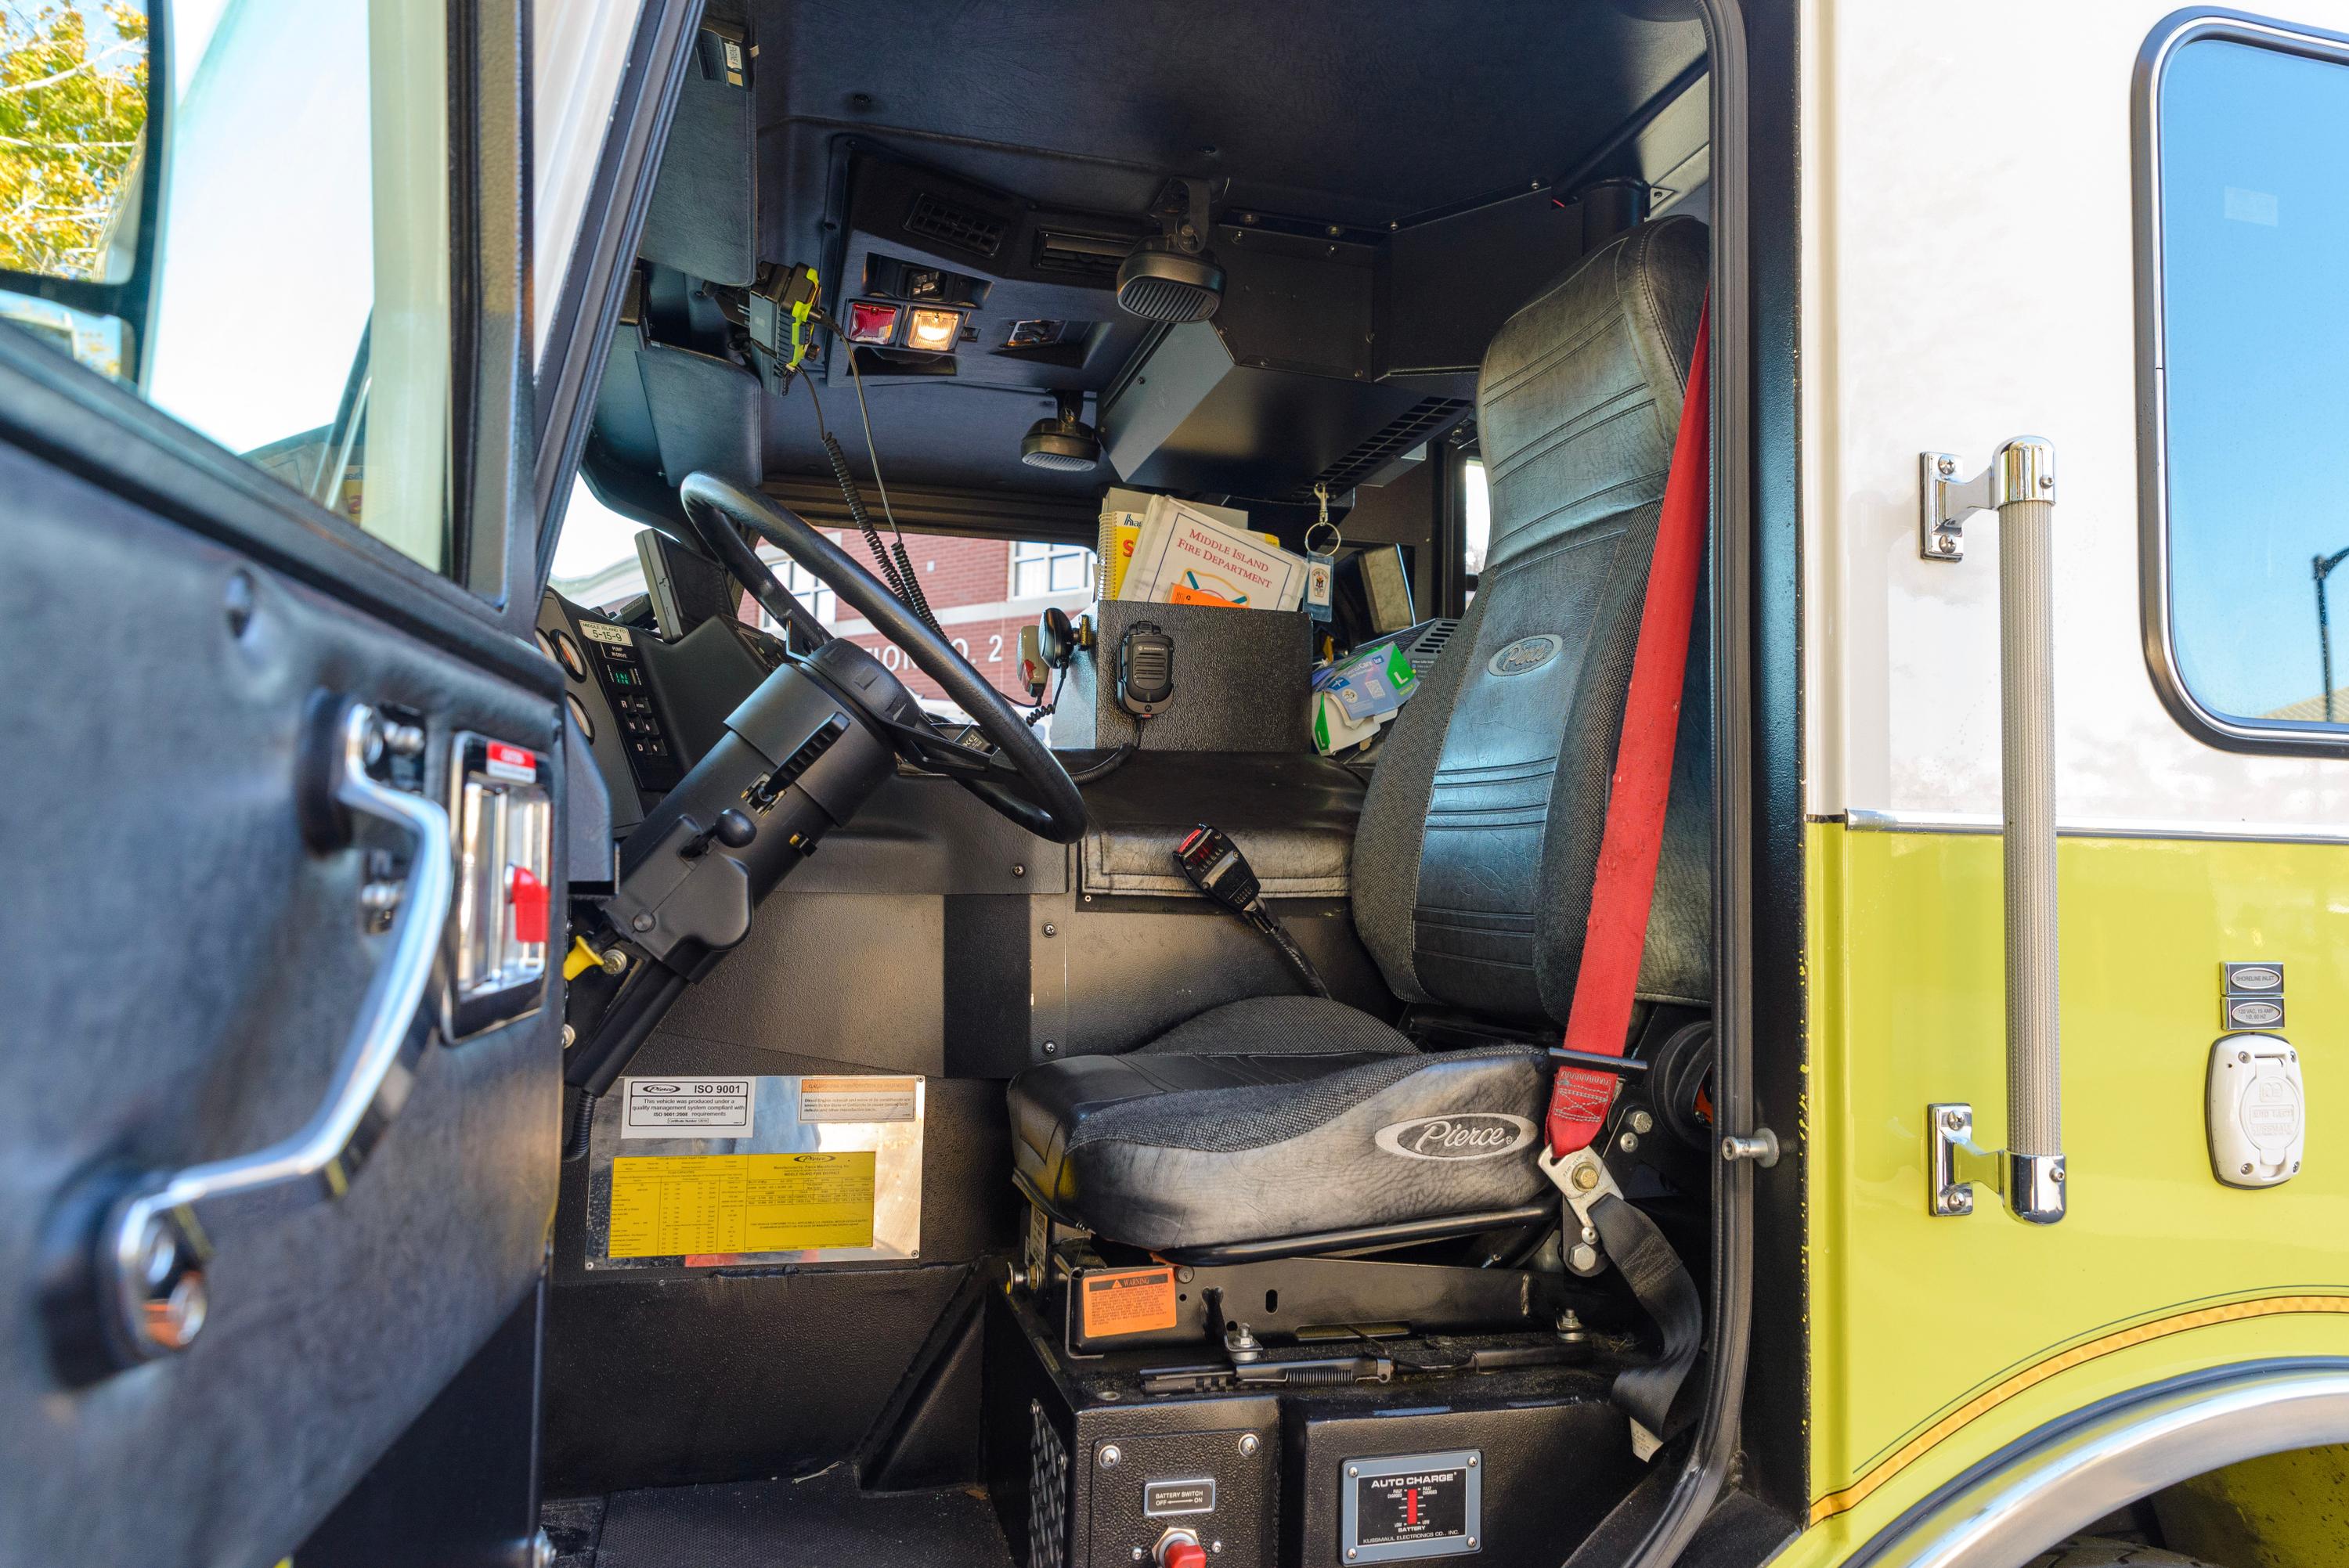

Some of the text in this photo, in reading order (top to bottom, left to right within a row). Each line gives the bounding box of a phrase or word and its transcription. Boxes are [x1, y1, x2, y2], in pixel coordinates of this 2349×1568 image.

[1189, 528, 1269, 572] MIDDLE ISLAND
[1177, 538, 1272, 589] FIRE DEPARTMENT
[593, 629, 622, 642] 5-15-9
[988, 635, 1003, 662] 2
[1394, 672, 1409, 685] L
[621, 700, 627, 708] R
[650, 1084, 673, 1094] Pierce
[695, 1085, 740, 1094] ISO 9001
[1414, 1120, 1506, 1152] Pierce
[1124, 1277, 1149, 1286] WARNING
[1370, 1473, 1454, 1488] AUTO CHARGE
[1396, 1532, 1434, 1541] ELECTRONICS
